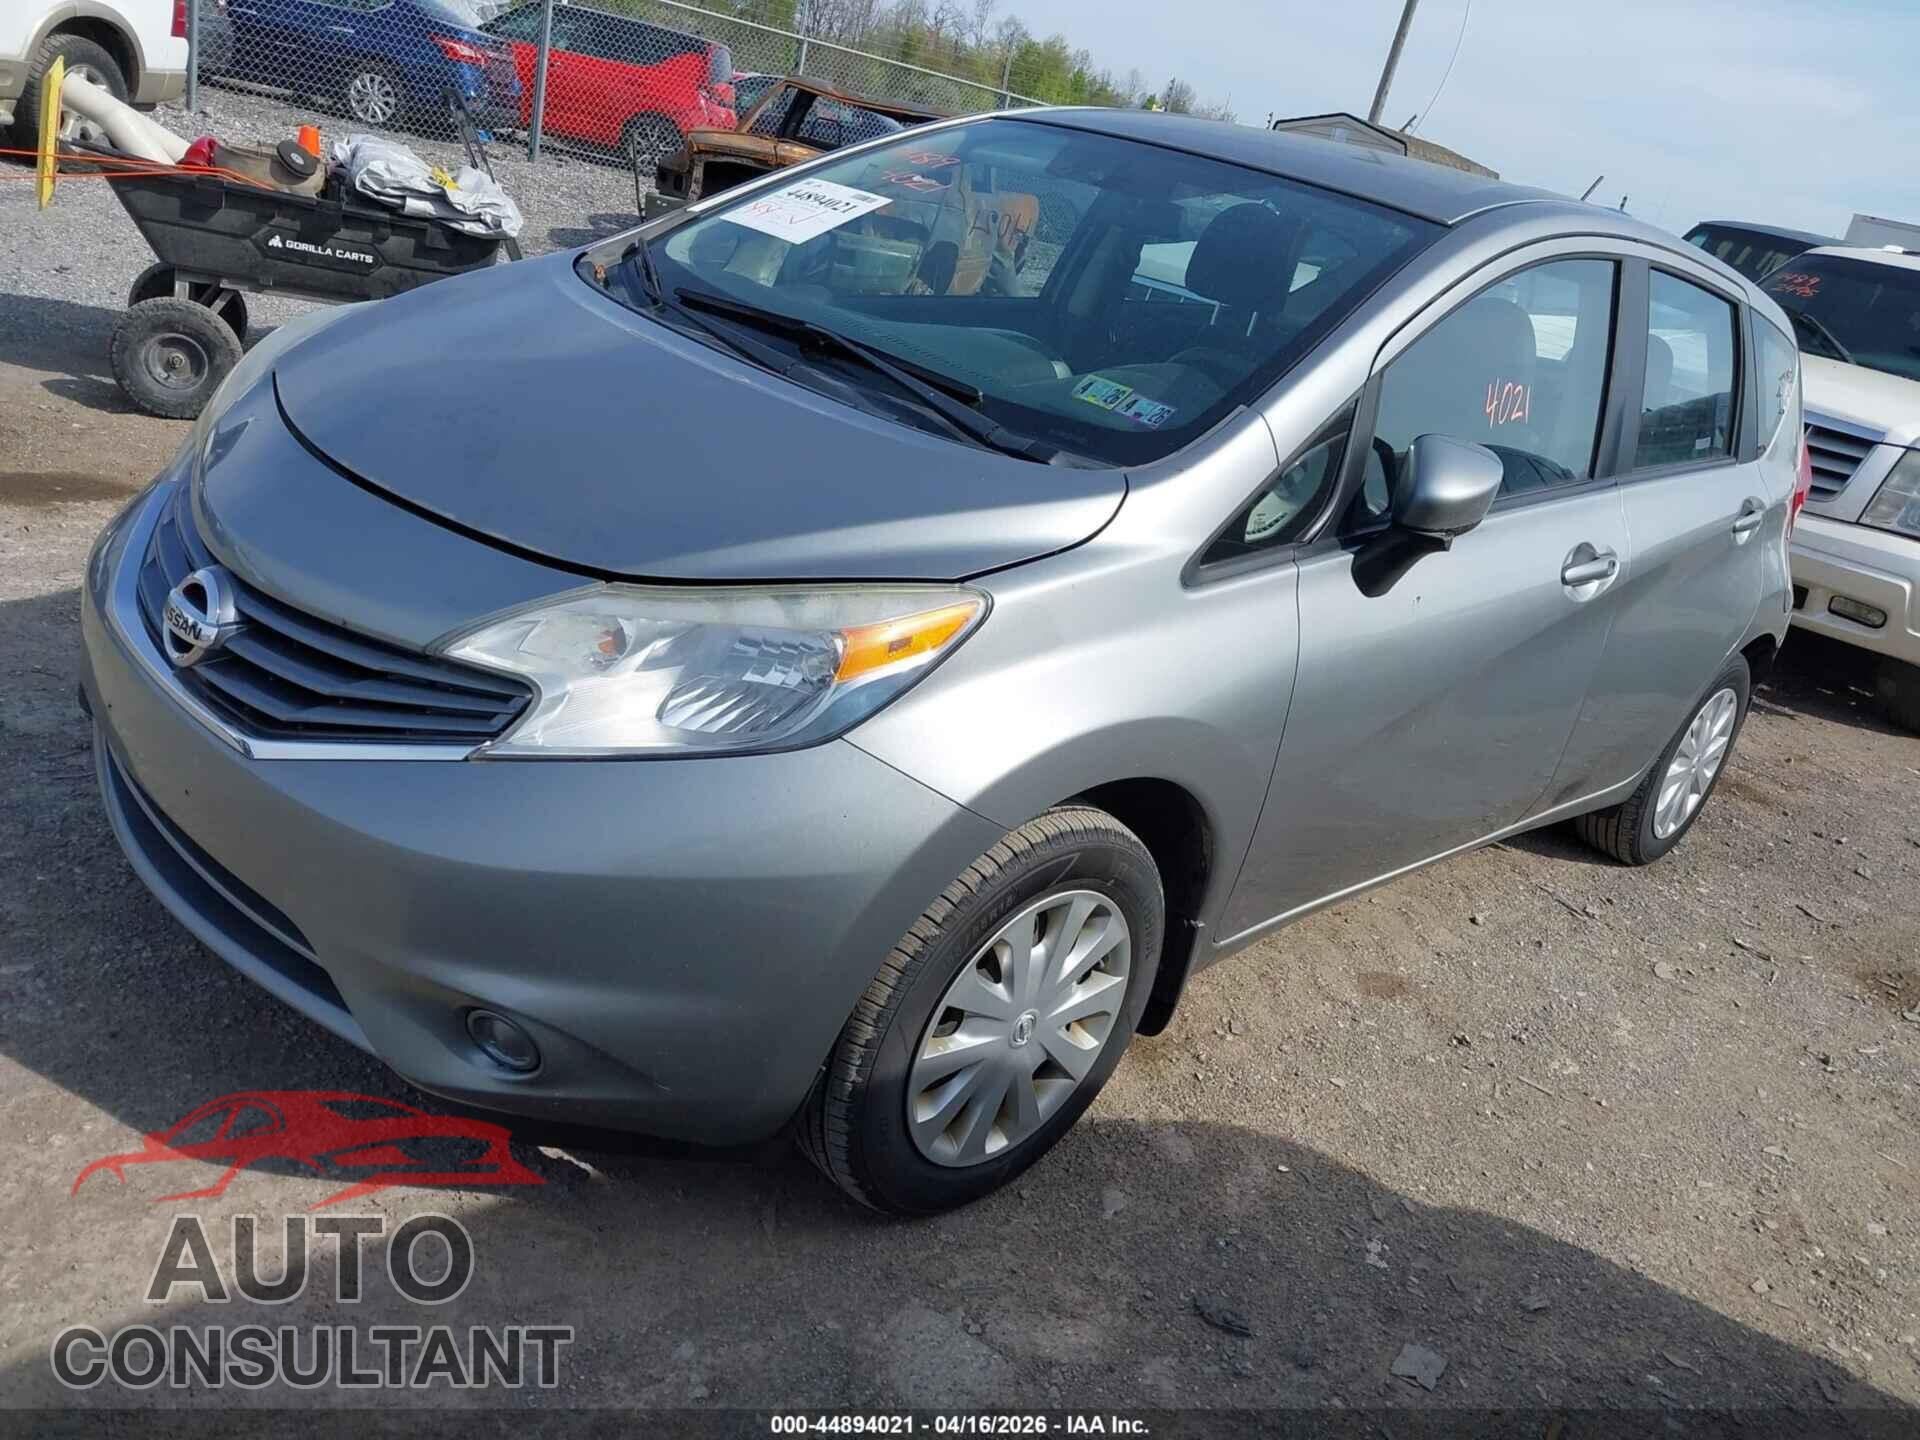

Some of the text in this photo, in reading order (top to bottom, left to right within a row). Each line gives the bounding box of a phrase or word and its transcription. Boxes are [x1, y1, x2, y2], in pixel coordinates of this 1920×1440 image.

[786, 190, 858, 214] 44894021
[285, 239, 374, 264] GORILLA CARTS
[1486, 376, 1531, 429] 4021
